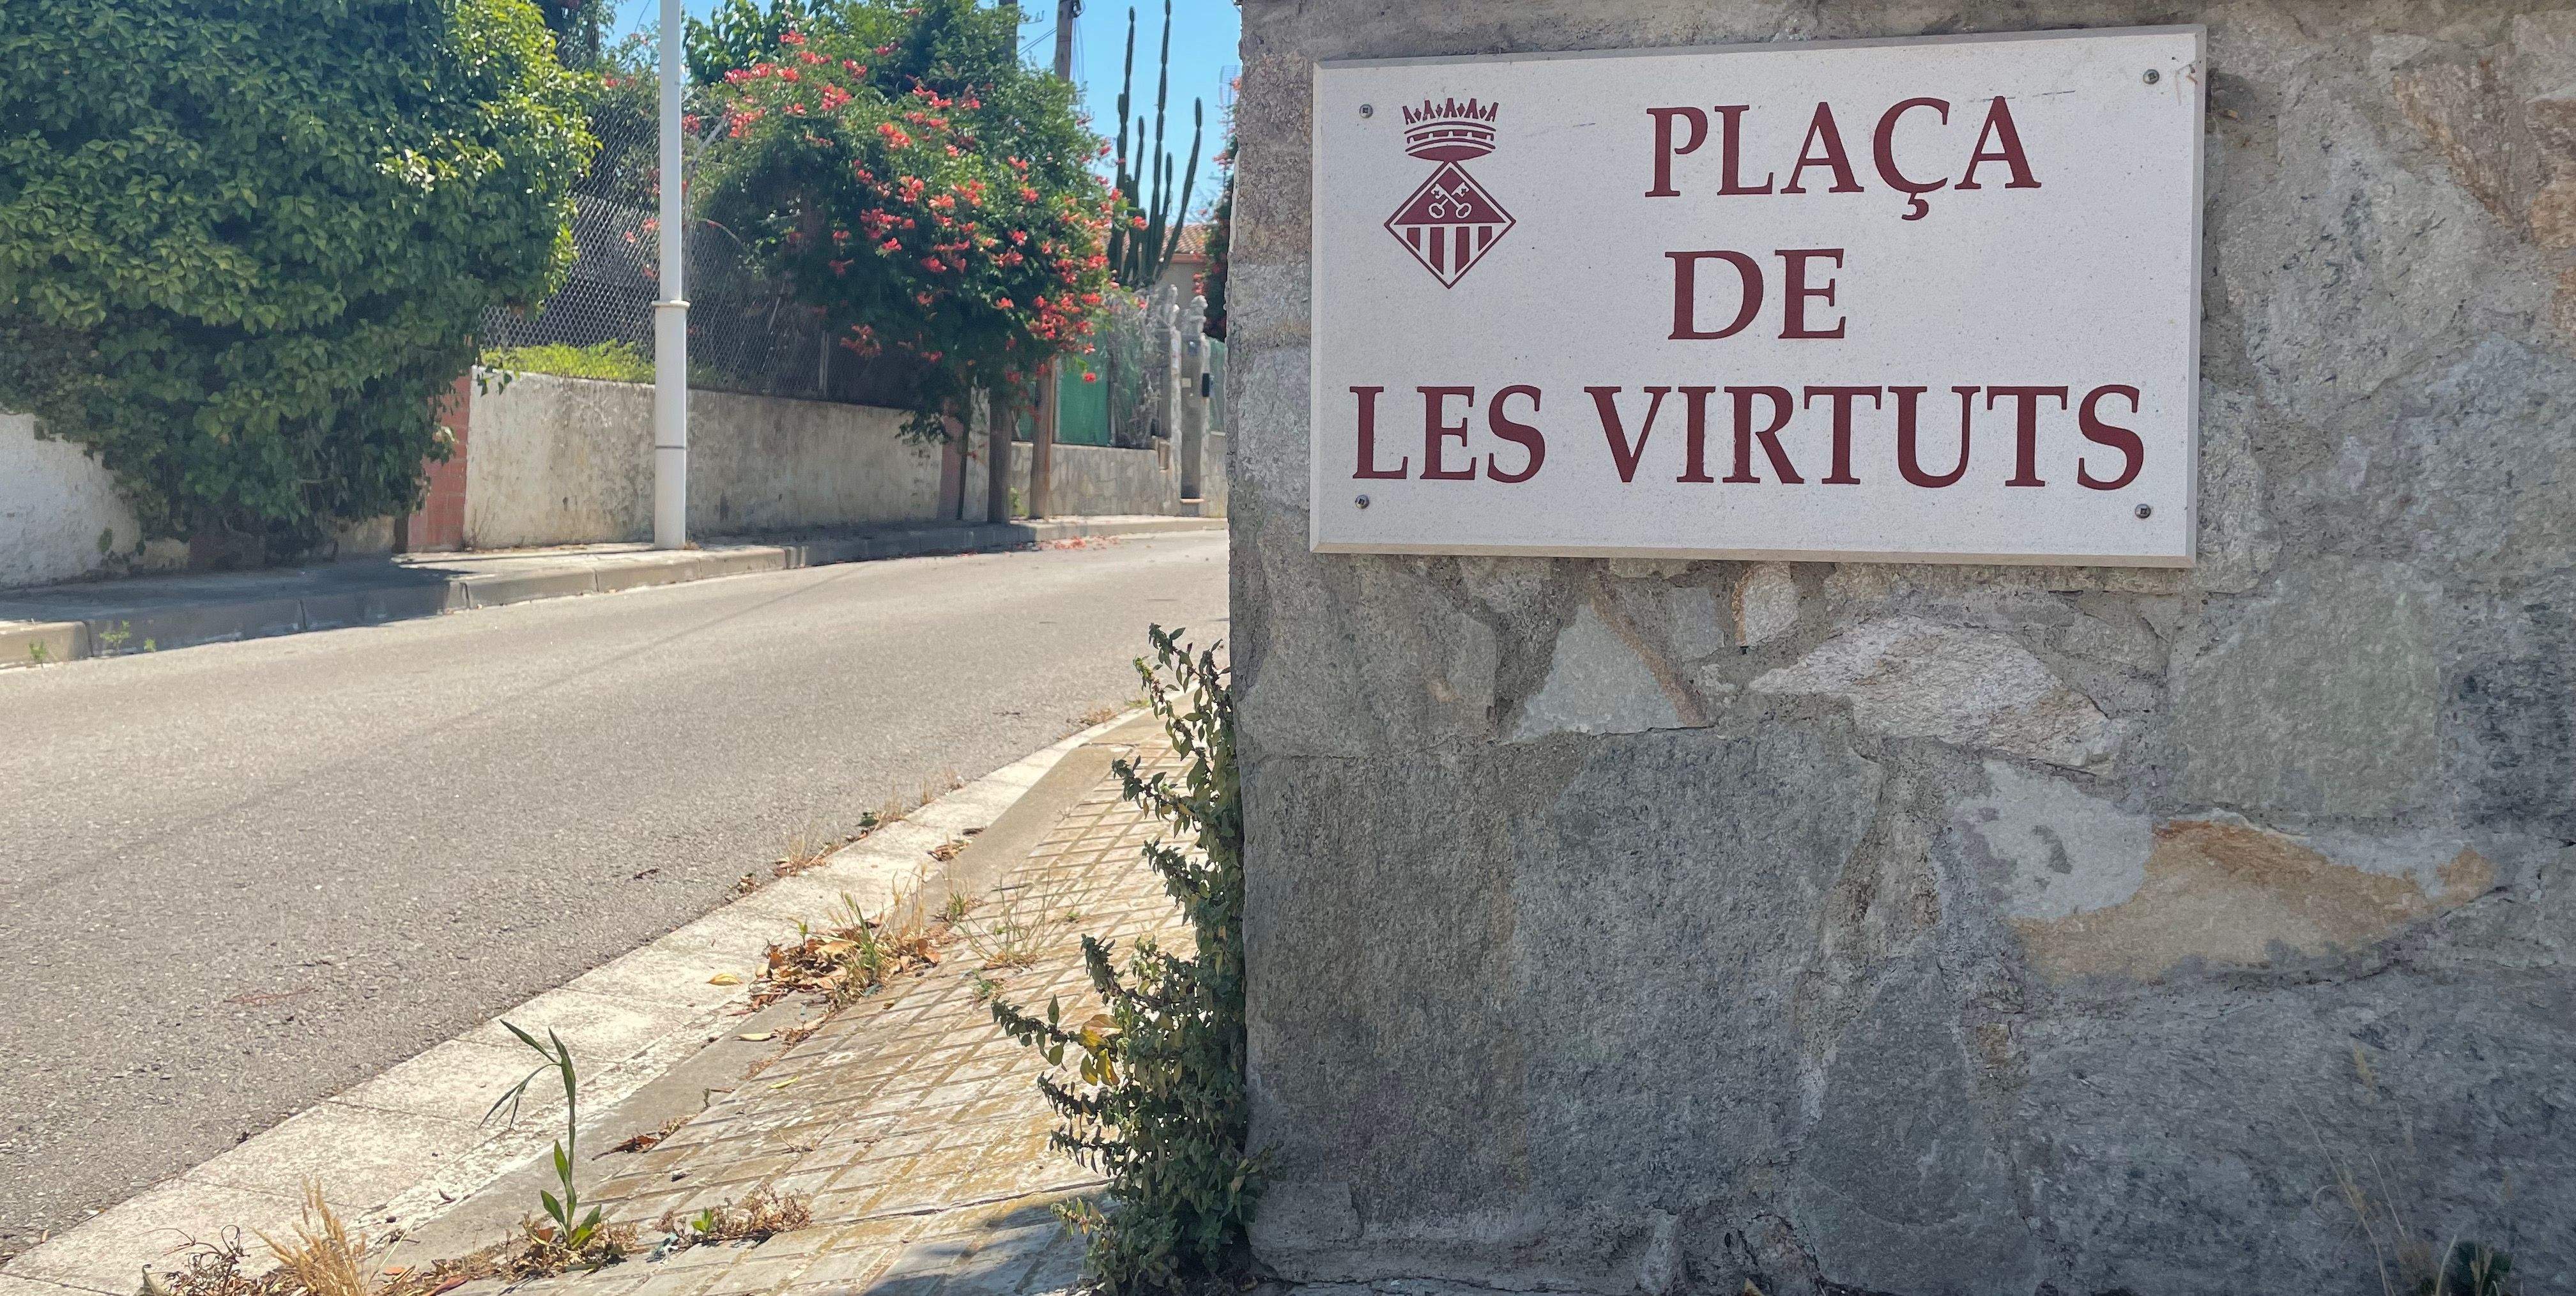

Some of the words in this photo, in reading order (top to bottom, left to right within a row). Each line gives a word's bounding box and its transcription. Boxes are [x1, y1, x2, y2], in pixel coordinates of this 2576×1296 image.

[1644, 95, 2042, 220] PLAÇA
[1665, 248, 1846, 340] DE
[1349, 385, 1545, 483] LES
[1584, 385, 2145, 490] VIRTUTS
